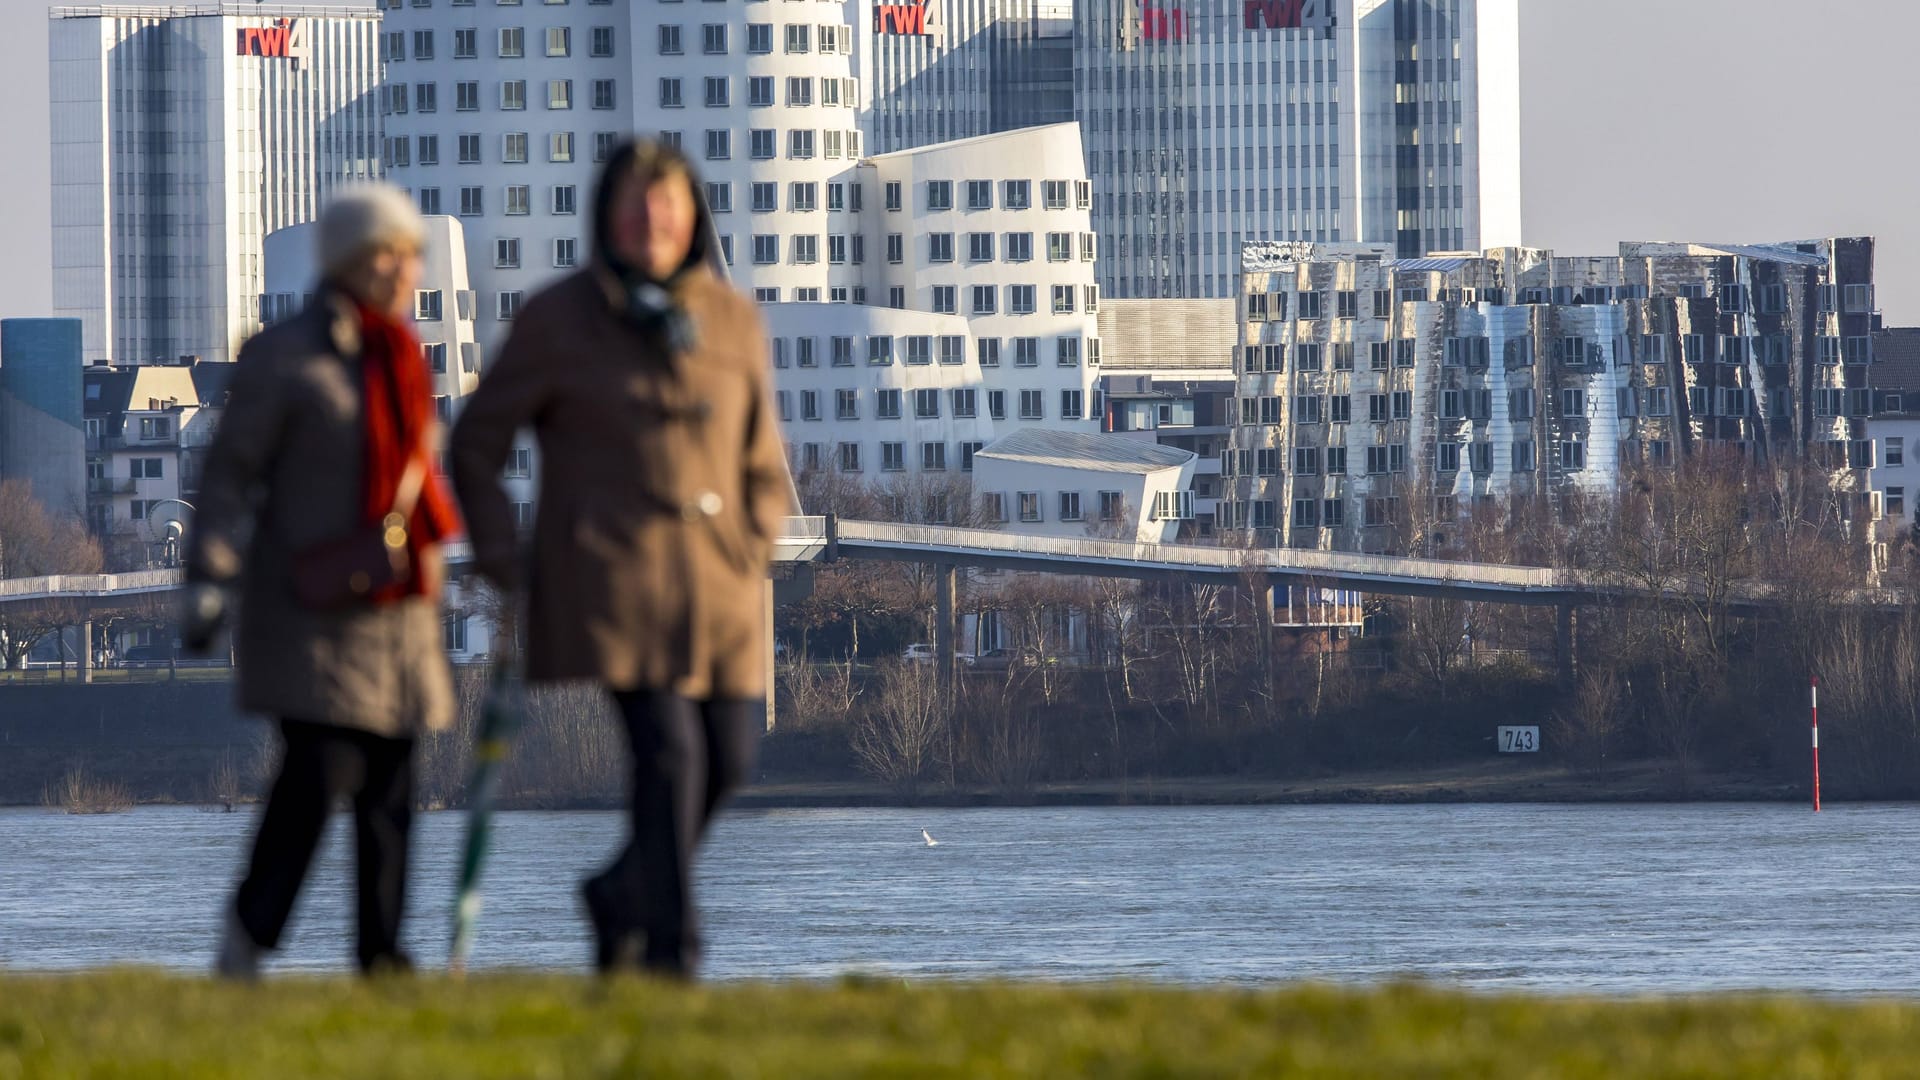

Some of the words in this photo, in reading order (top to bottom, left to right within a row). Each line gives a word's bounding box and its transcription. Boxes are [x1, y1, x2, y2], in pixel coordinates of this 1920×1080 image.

[244, 17, 311, 69] rwi4
[880, 0, 945, 47] rwi4
[1505, 731, 1533, 750] 743
